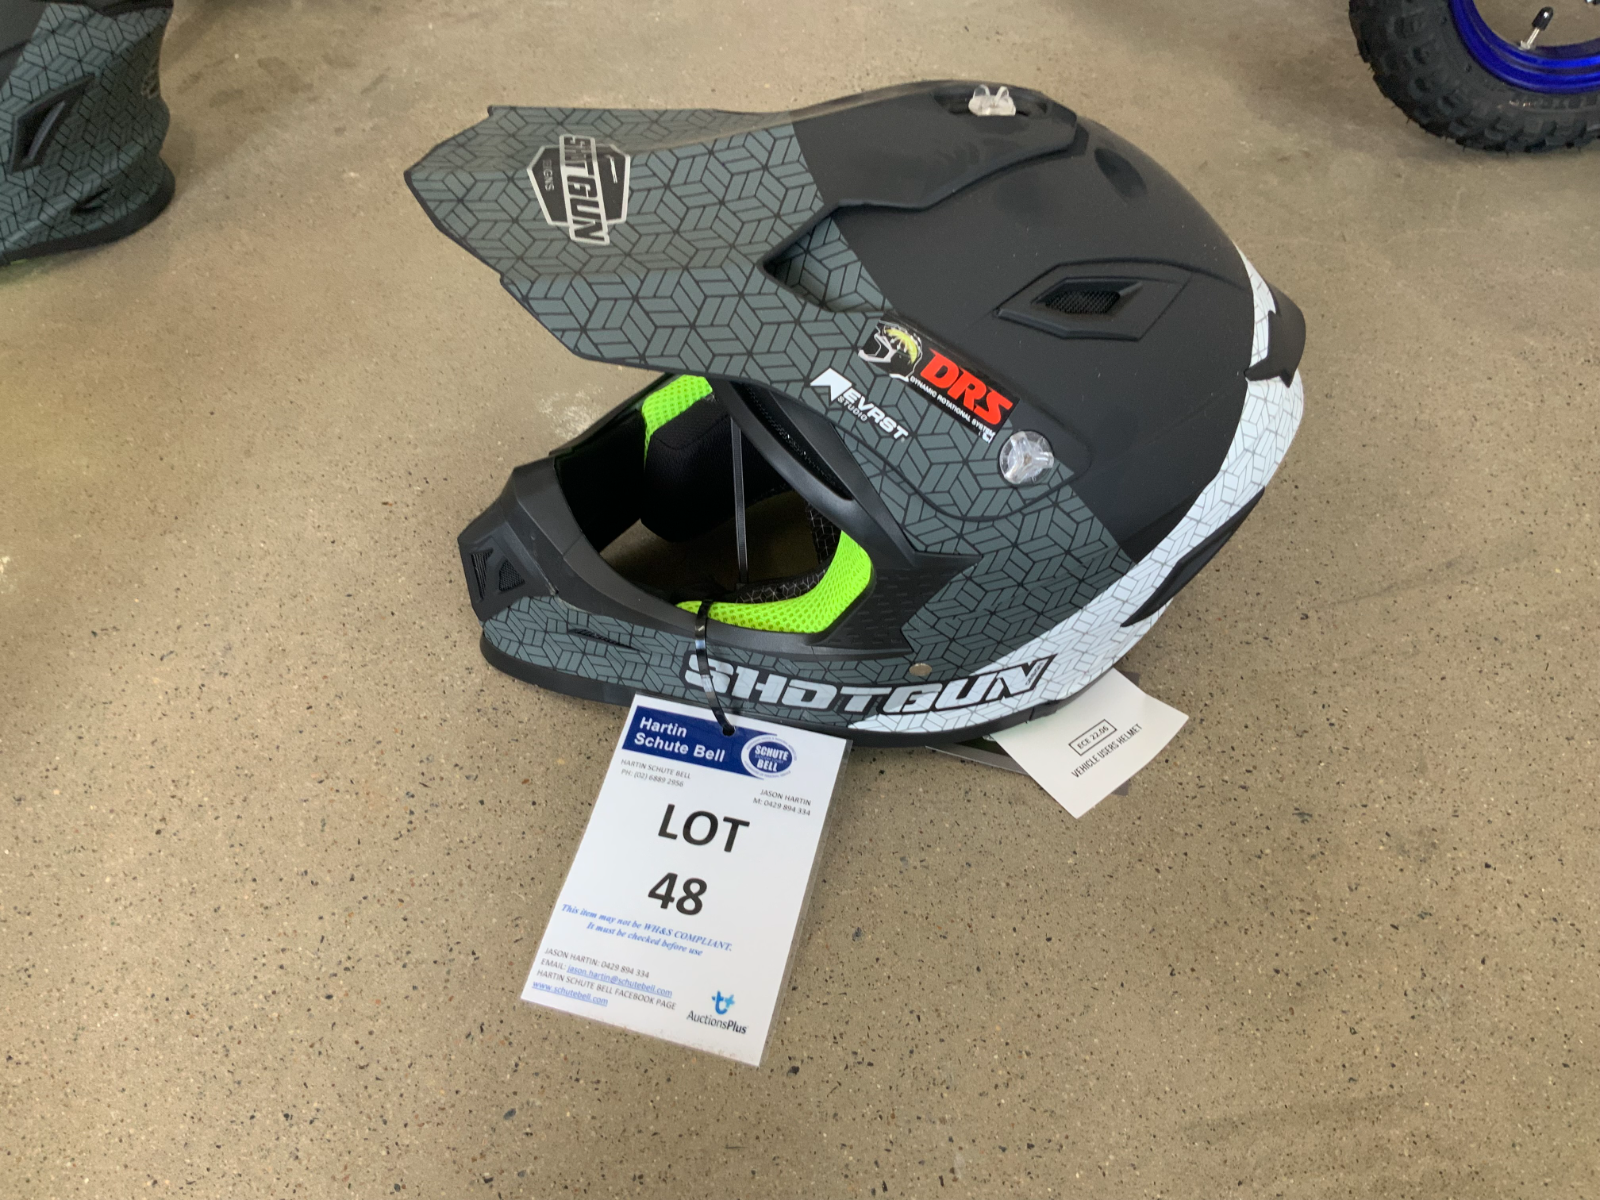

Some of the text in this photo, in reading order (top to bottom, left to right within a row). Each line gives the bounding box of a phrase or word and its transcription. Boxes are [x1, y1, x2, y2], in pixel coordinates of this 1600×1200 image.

[909, 375, 938, 398] DYNAMIC
[936, 393, 972, 422] ROTATIONAL
[919, 347, 1013, 426] DRS
[837, 395, 868, 422] STUDIO
[843, 388, 909, 440] EVRST
[684, 653, 1056, 713] SHOTGUN
[640, 716, 687, 738] Hartin
[1077, 725, 1109, 750] ECE 22.06
[634, 732, 689, 754] Schute
[693, 743, 725, 763] Bell
[755, 744, 789, 761] SCHUTE
[1071, 723, 1142, 778] VEHICLE USERS HELMET
[620, 759, 691, 780] HARTIN SCHUTE BELL
[756, 758, 777, 772] BELL
[752, 796, 763, 805] M:
[763, 799, 782, 809] 0429
[782, 803, 796, 813] 894
[760, 788, 812, 807] JASON HARTIN
[658, 804, 750, 853] LOT
[647, 872, 708, 916] 48
[561, 903, 733, 953] This item may not be WH&S COMPLIANT.
[586, 921, 704, 957] It must be checked before use
[540, 957, 673, 999] EMAIL: jason.hartin@schutebell.com
[544, 946, 650, 979] JASON HARTIN: 0429 894 334
[531, 980, 609, 1008] www.schutebell.com
[536, 968, 677, 1011] HARTIN SCHUTE BELL FACEBOOK PAGE
[686, 1009, 748, 1035] AuctionsPlus
